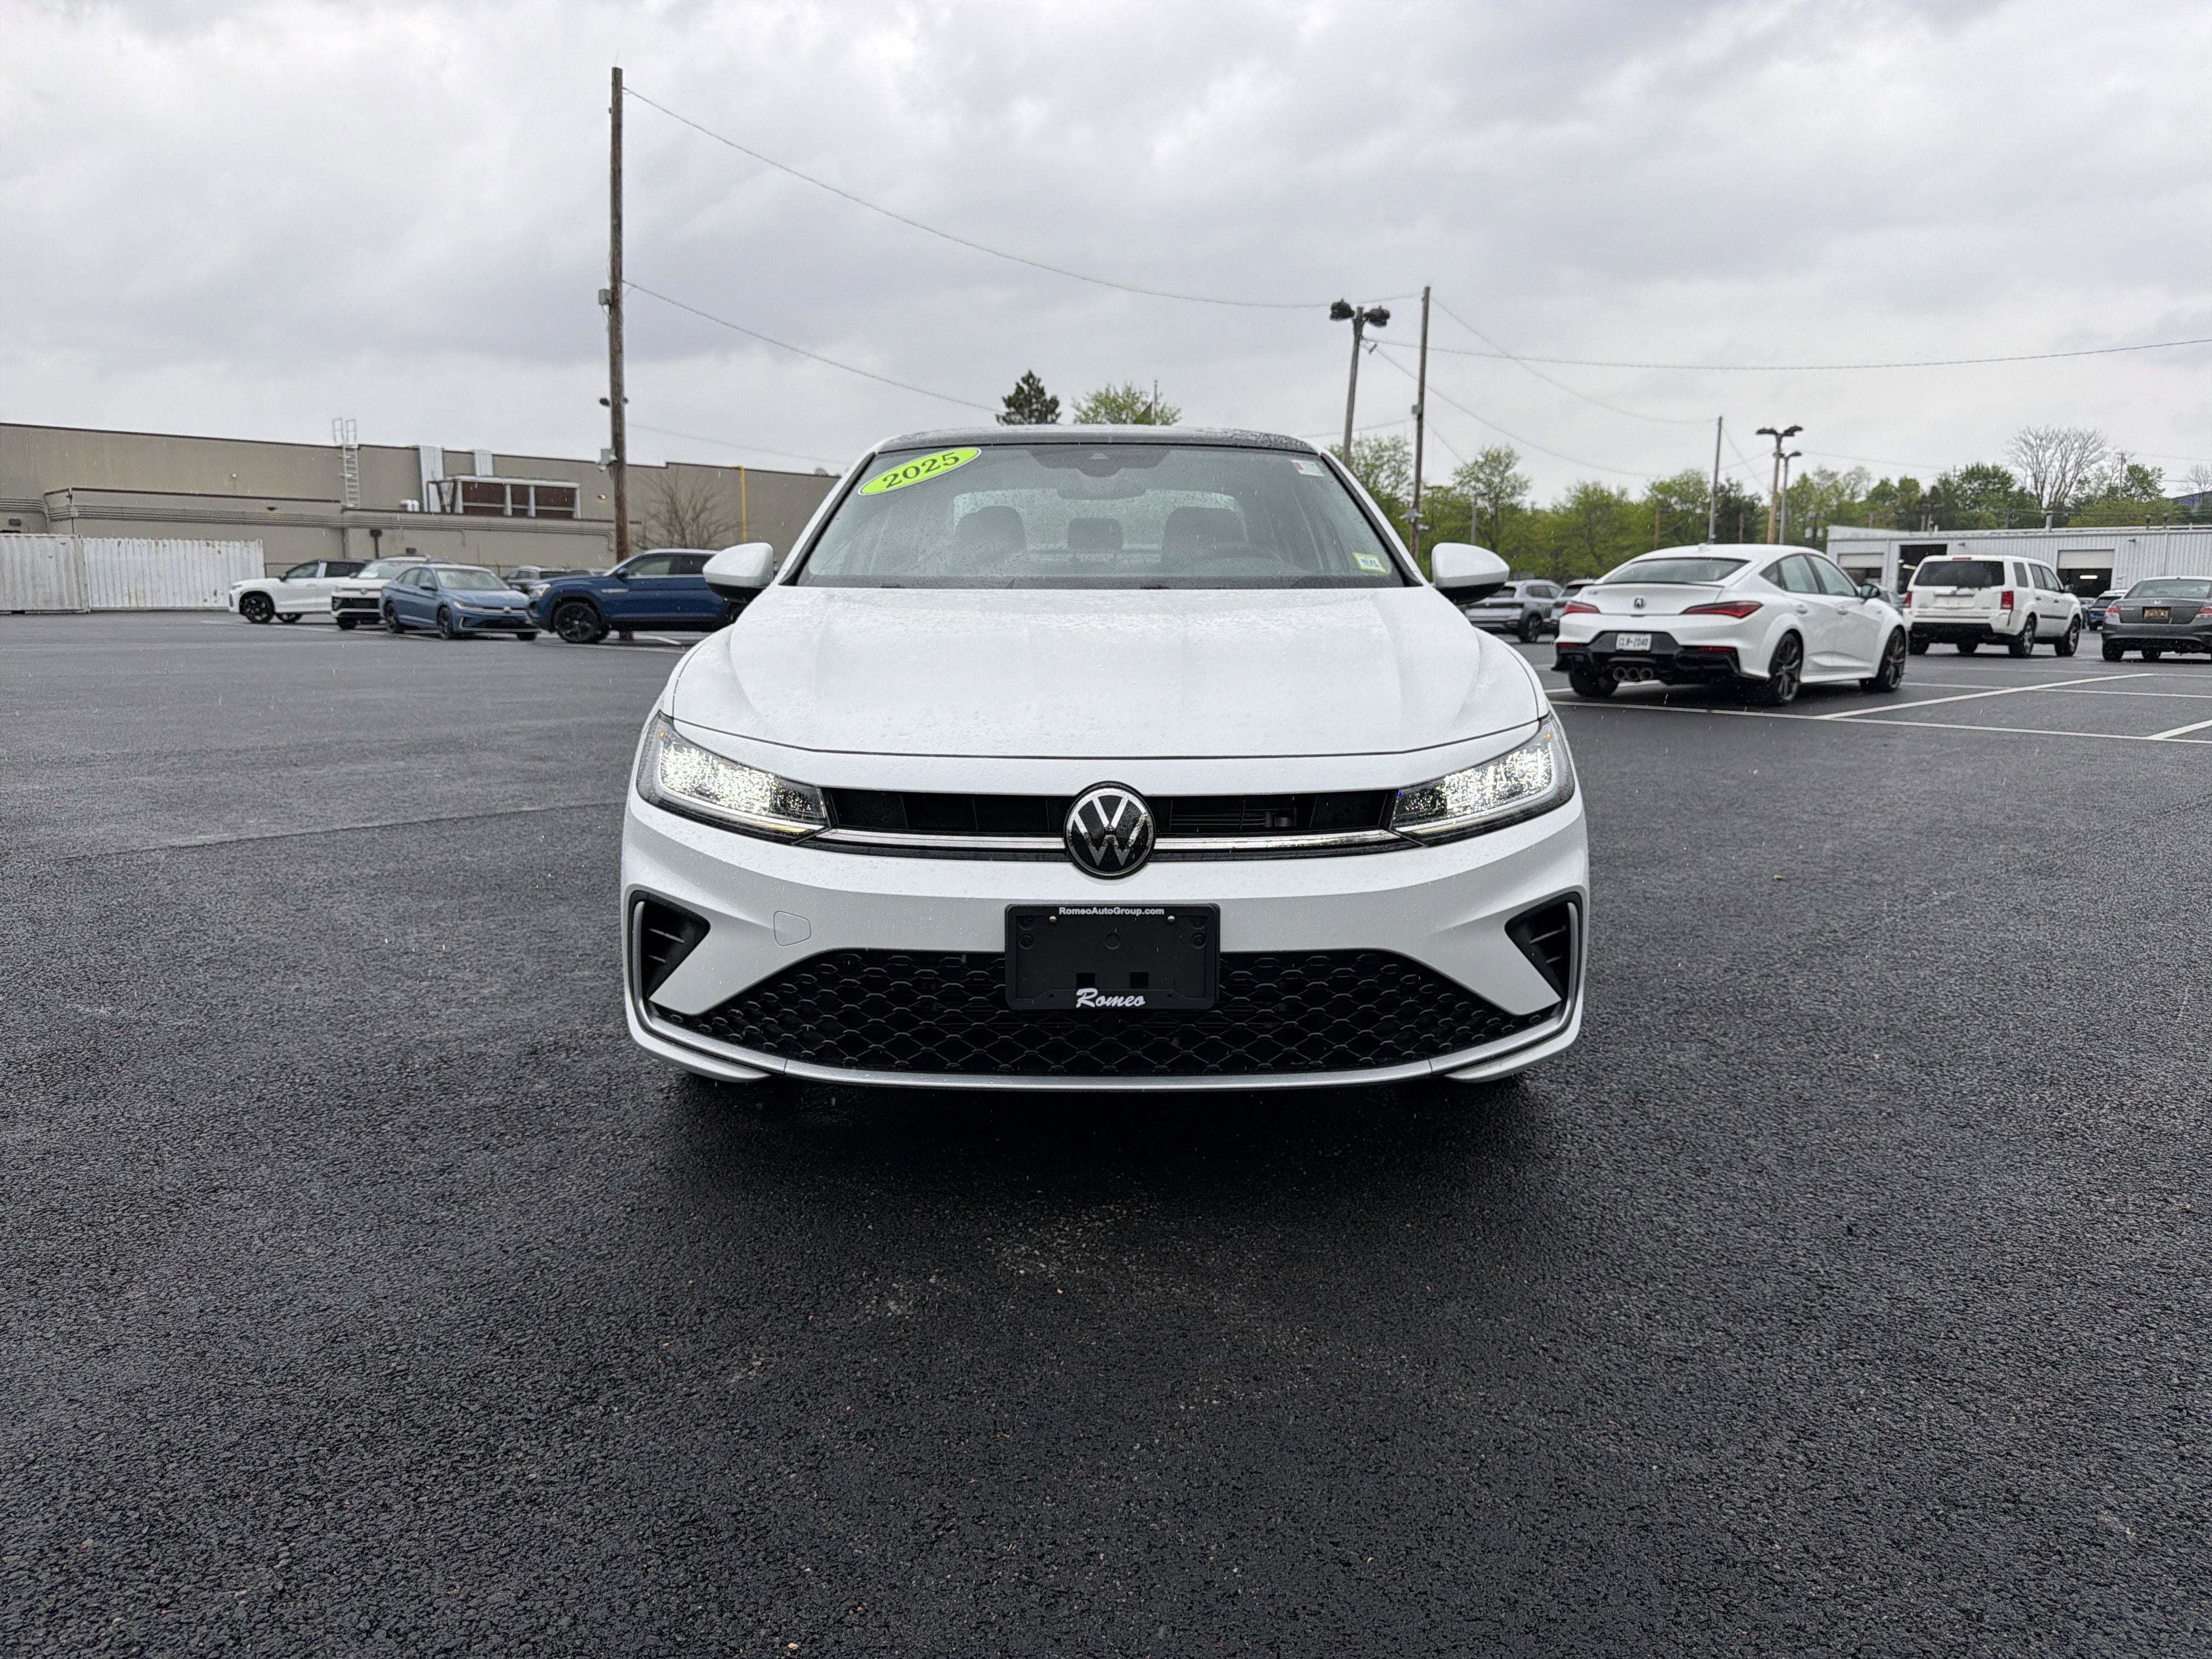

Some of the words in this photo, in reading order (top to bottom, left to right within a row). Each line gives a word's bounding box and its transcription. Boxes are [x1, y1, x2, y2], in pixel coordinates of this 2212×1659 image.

[883, 452, 960, 489] 2025
[1066, 788, 1154, 876] VW
[1058, 907, 1165, 916] RomeoAutoGroup.com
[1075, 988, 1146, 1008] Romeo
